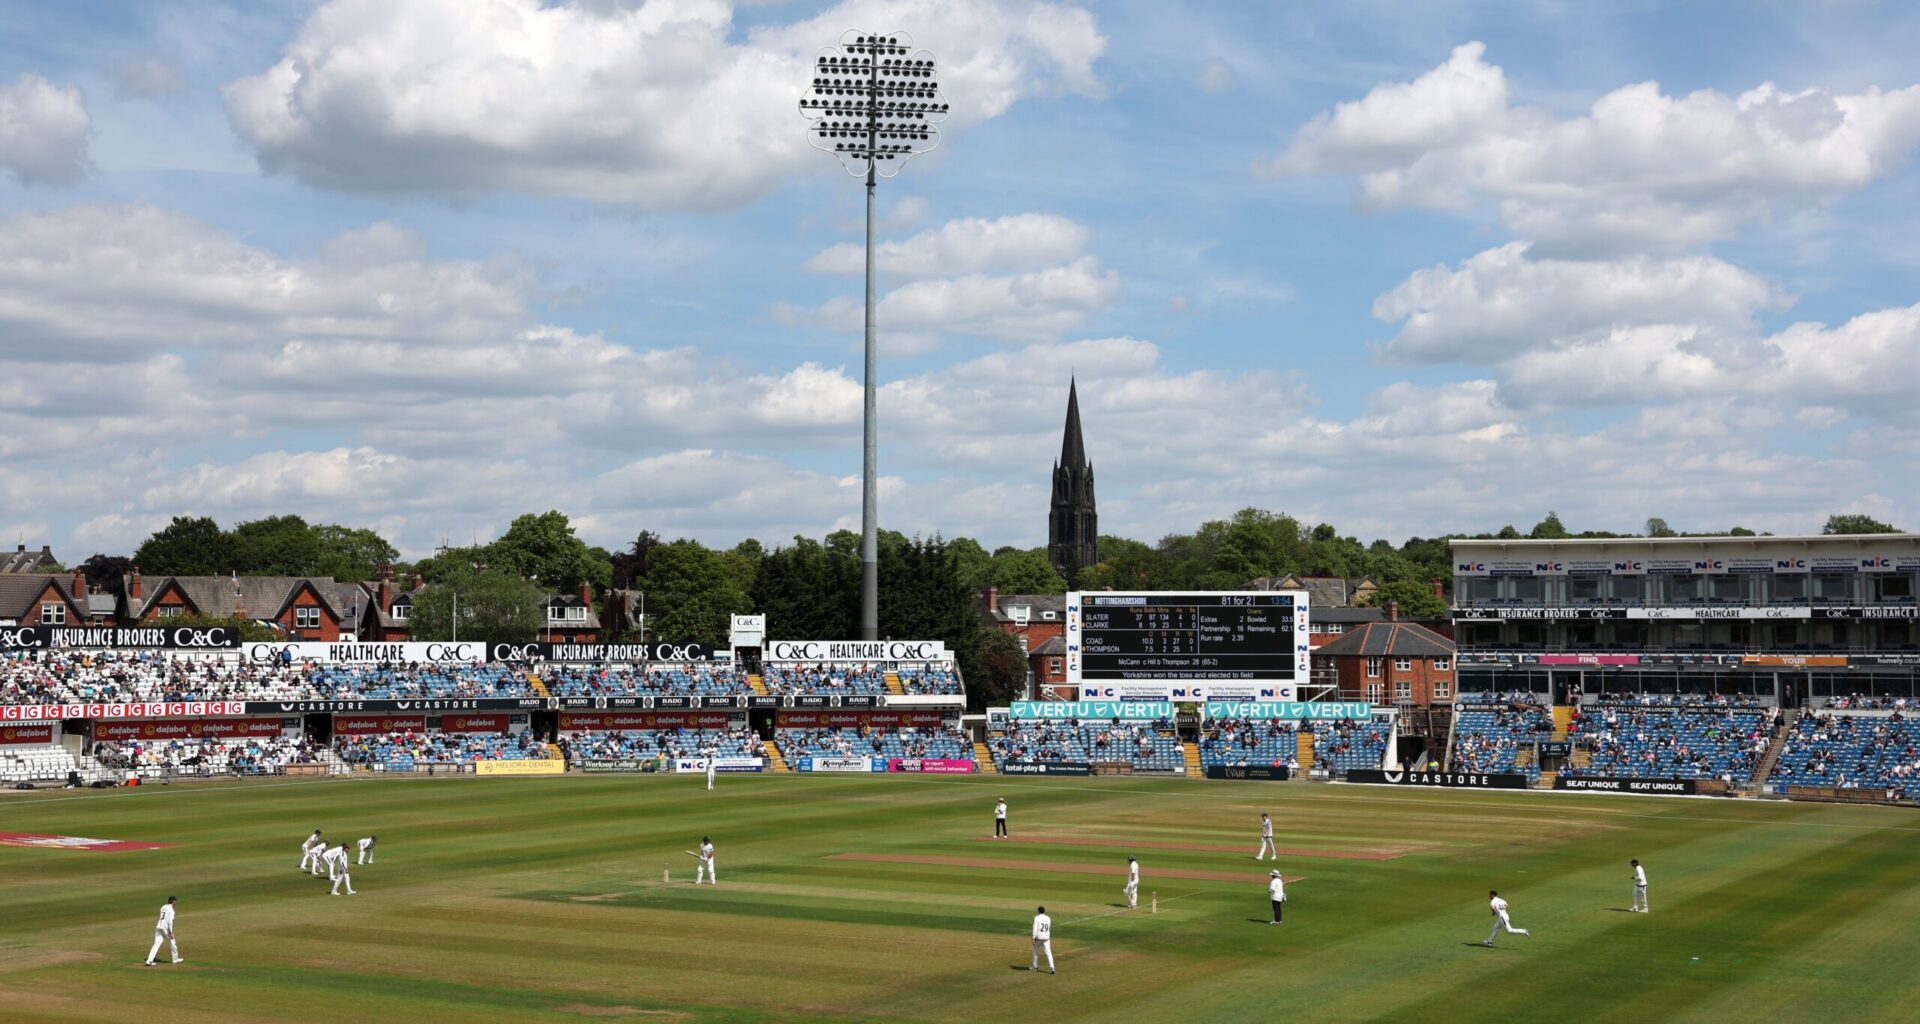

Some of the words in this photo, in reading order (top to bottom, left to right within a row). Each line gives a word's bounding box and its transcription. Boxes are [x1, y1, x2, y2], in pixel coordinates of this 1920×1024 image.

[1222, 597, 1231, 605] 81
[1234, 597, 1244, 605] for
[1498, 610, 1541, 618] INSURANCE
[1544, 610, 1579, 618] BROKERS
[1862, 609, 1910, 618] INSURANCE
[0, 628, 42, 646] &C.
[52, 628, 112, 645] INSURANCE
[117, 628, 165, 645] BROKERS
[330, 645, 404, 660] HEALTHCARE
[553, 644, 604, 660] INSURANCE
[608, 644, 648, 660] BROKERS
[830, 644, 884, 658] HEALTHCARE
[3, 707, 17, 719] IG
[25, 707, 38, 718] IG
[46, 706, 59, 717] IG
[87, 706, 100, 716] IG
[128, 704, 142, 715] IG
[169, 704, 182, 715] IG
[209, 703, 222, 714] IG
[229, 703, 241, 713] IG
[299, 702, 363, 711] CASTORE
[1031, 704, 1088, 717] VERTU
[1111, 704, 1170, 717] VERTU
[1225, 704, 1285, 717] VERTU
[1308, 704, 1368, 717] VERTU
[17, 729, 48, 737] dafabet
[109, 727, 139, 735] dafabet
[1410, 774, 1488, 785] CASTORE
[1040, 923, 1048, 932] 29
